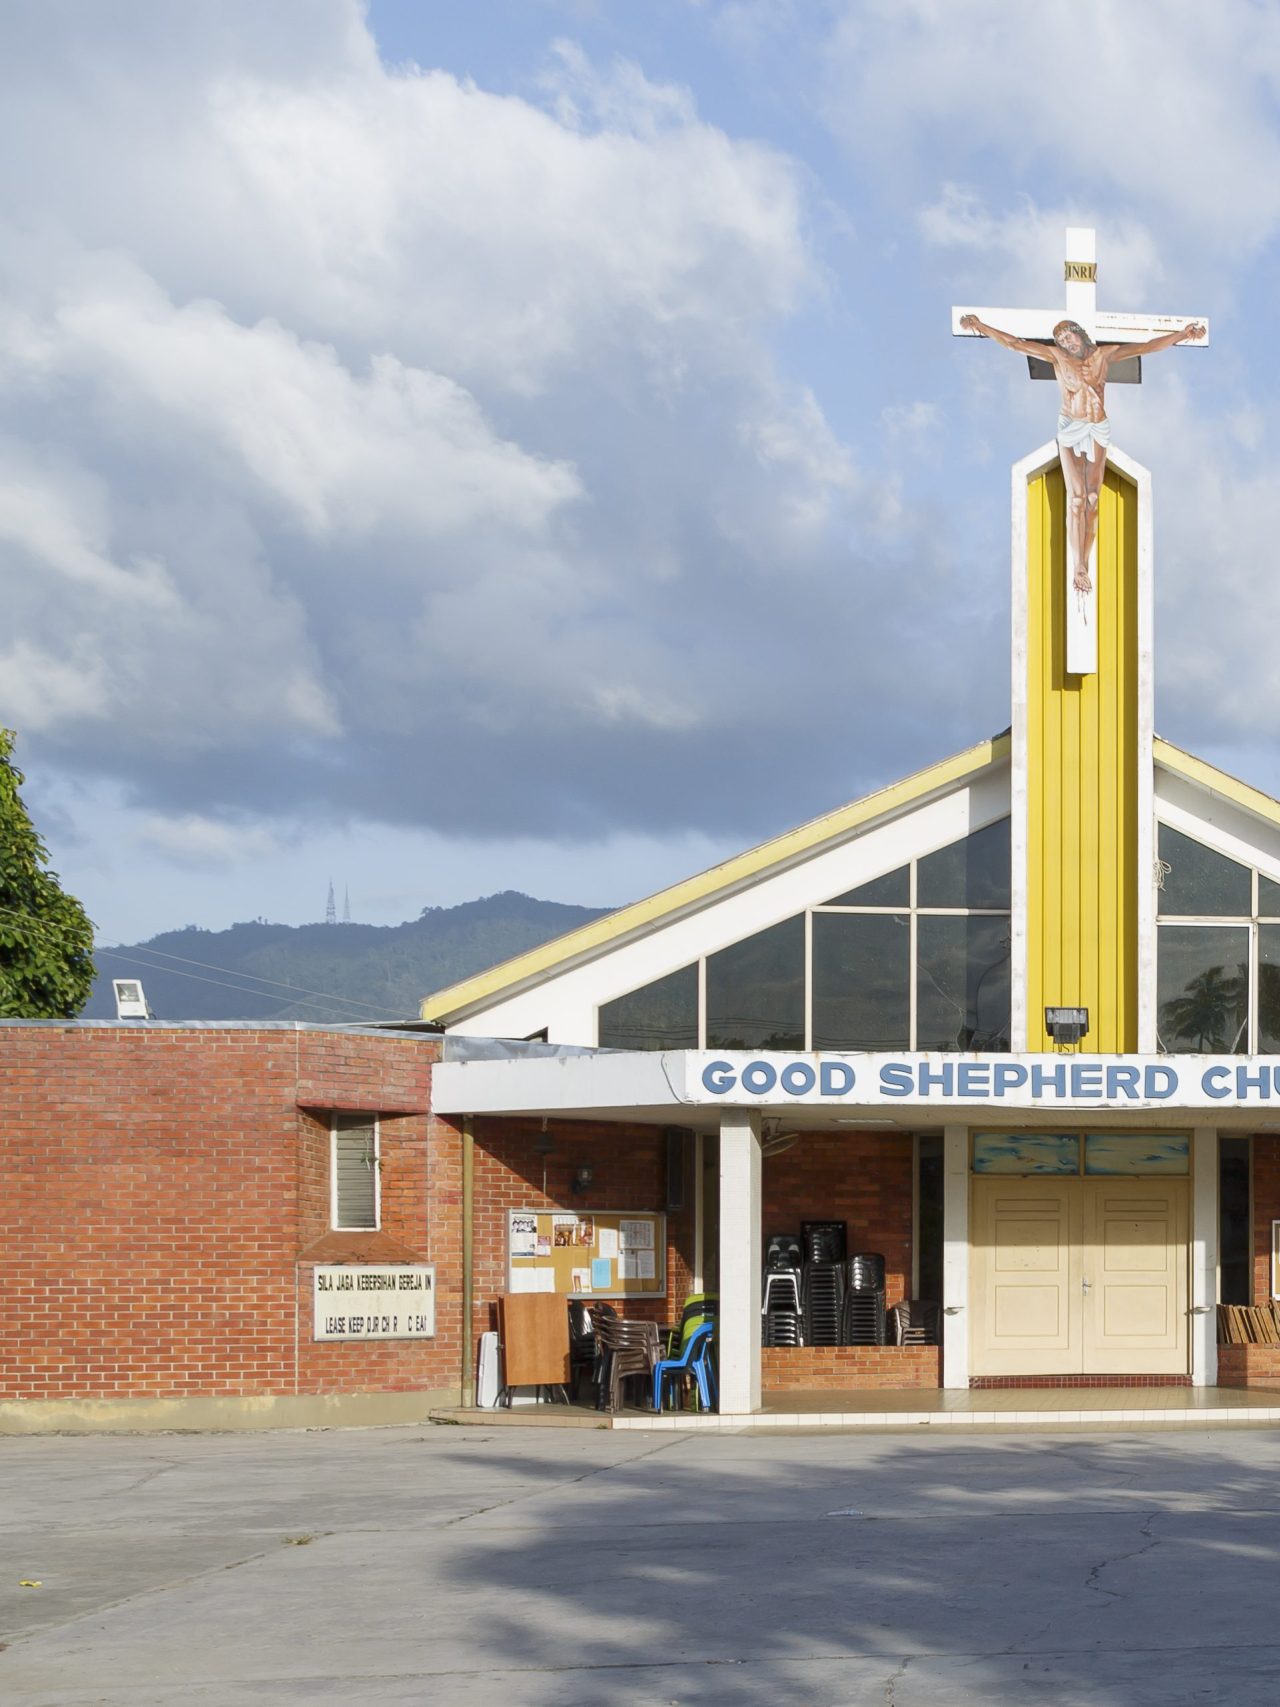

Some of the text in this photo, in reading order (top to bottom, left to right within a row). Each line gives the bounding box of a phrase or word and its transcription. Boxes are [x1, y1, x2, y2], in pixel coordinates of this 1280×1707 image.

[1068, 265, 1092, 279] INRI
[702, 1060, 856, 1095] GOOD
[879, 1062, 1179, 1098] SHEPHERD
[318, 1274, 333, 1291] SILA
[336, 1274, 354, 1291] JAGA
[357, 1274, 396, 1290] KEBERSIHAN
[399, 1274, 423, 1290] GEREJA
[348, 1316, 364, 1333] KEEP
